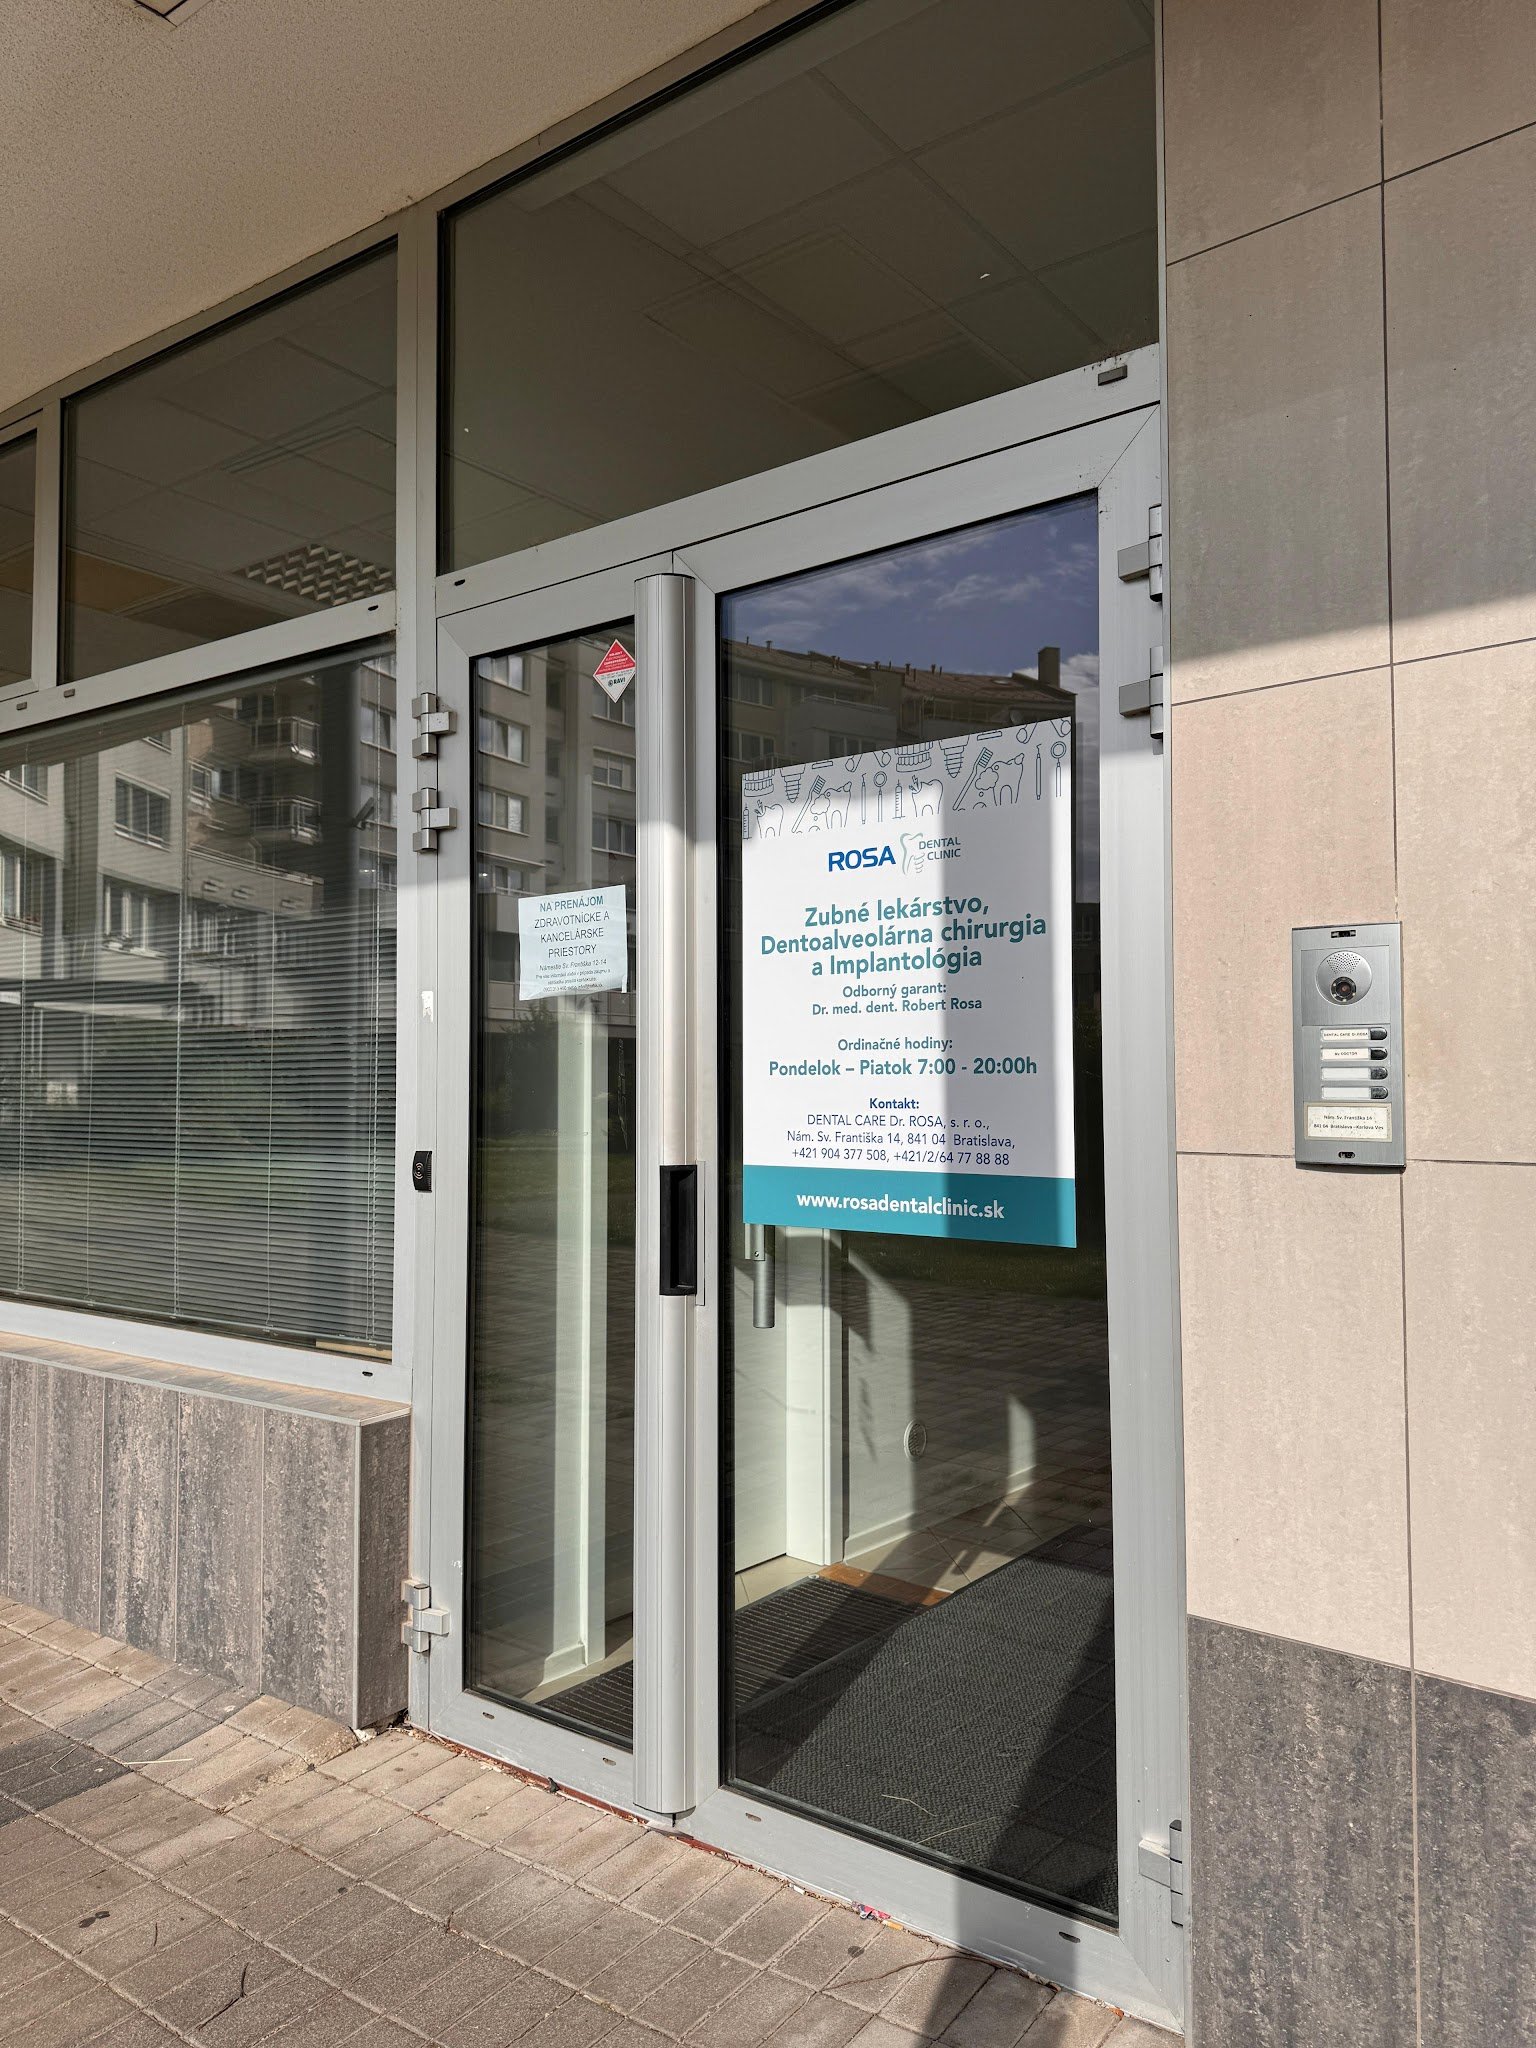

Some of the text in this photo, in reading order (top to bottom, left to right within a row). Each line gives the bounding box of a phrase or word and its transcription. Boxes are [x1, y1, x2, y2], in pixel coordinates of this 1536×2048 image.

[918, 837, 961, 850] DENTAL
[828, 846, 895, 872] ROSA
[927, 848, 961, 861] CLINIC
[540, 896, 604, 912] NA PRENÁJOM
[805, 896, 989, 927] Zubné lekárstvo,
[534, 911, 610, 929] ZDRAVOTNÍCKE A
[540, 927, 604, 943] KANCELÁRSKE
[761, 914, 1047, 955] Dentoalveolárna chirurgia
[548, 944, 597, 959] PRIESTORY
[812, 946, 982, 979] a Implantológia
[842, 982, 947, 999] Odborný garant:
[812, 997, 982, 1016] Dr. med. dent. Robert Rosa
[838, 1037, 953, 1051] Ordinačné hodiny:
[769, 1060, 840, 1076] Pondelok
[859, 1060, 912, 1075] Piatok
[918, 1059, 956, 1075] 7:00
[974, 1057, 1037, 1075] 20:00h
[869, 1098, 919, 1110] Kontakt:
[807, 1115, 989, 1130] DENTAL CARE Dr. ROSA, s. r. o.,
[787, 1131, 1015, 1148] Nám. Sv. Františka 14, 841 04 Bratislava,
[792, 1149, 1010, 1165] +421 904 377 508, +421/2/64 77 88 88
[796, 1193, 1004, 1219] www.rosadentalclinic.sk
